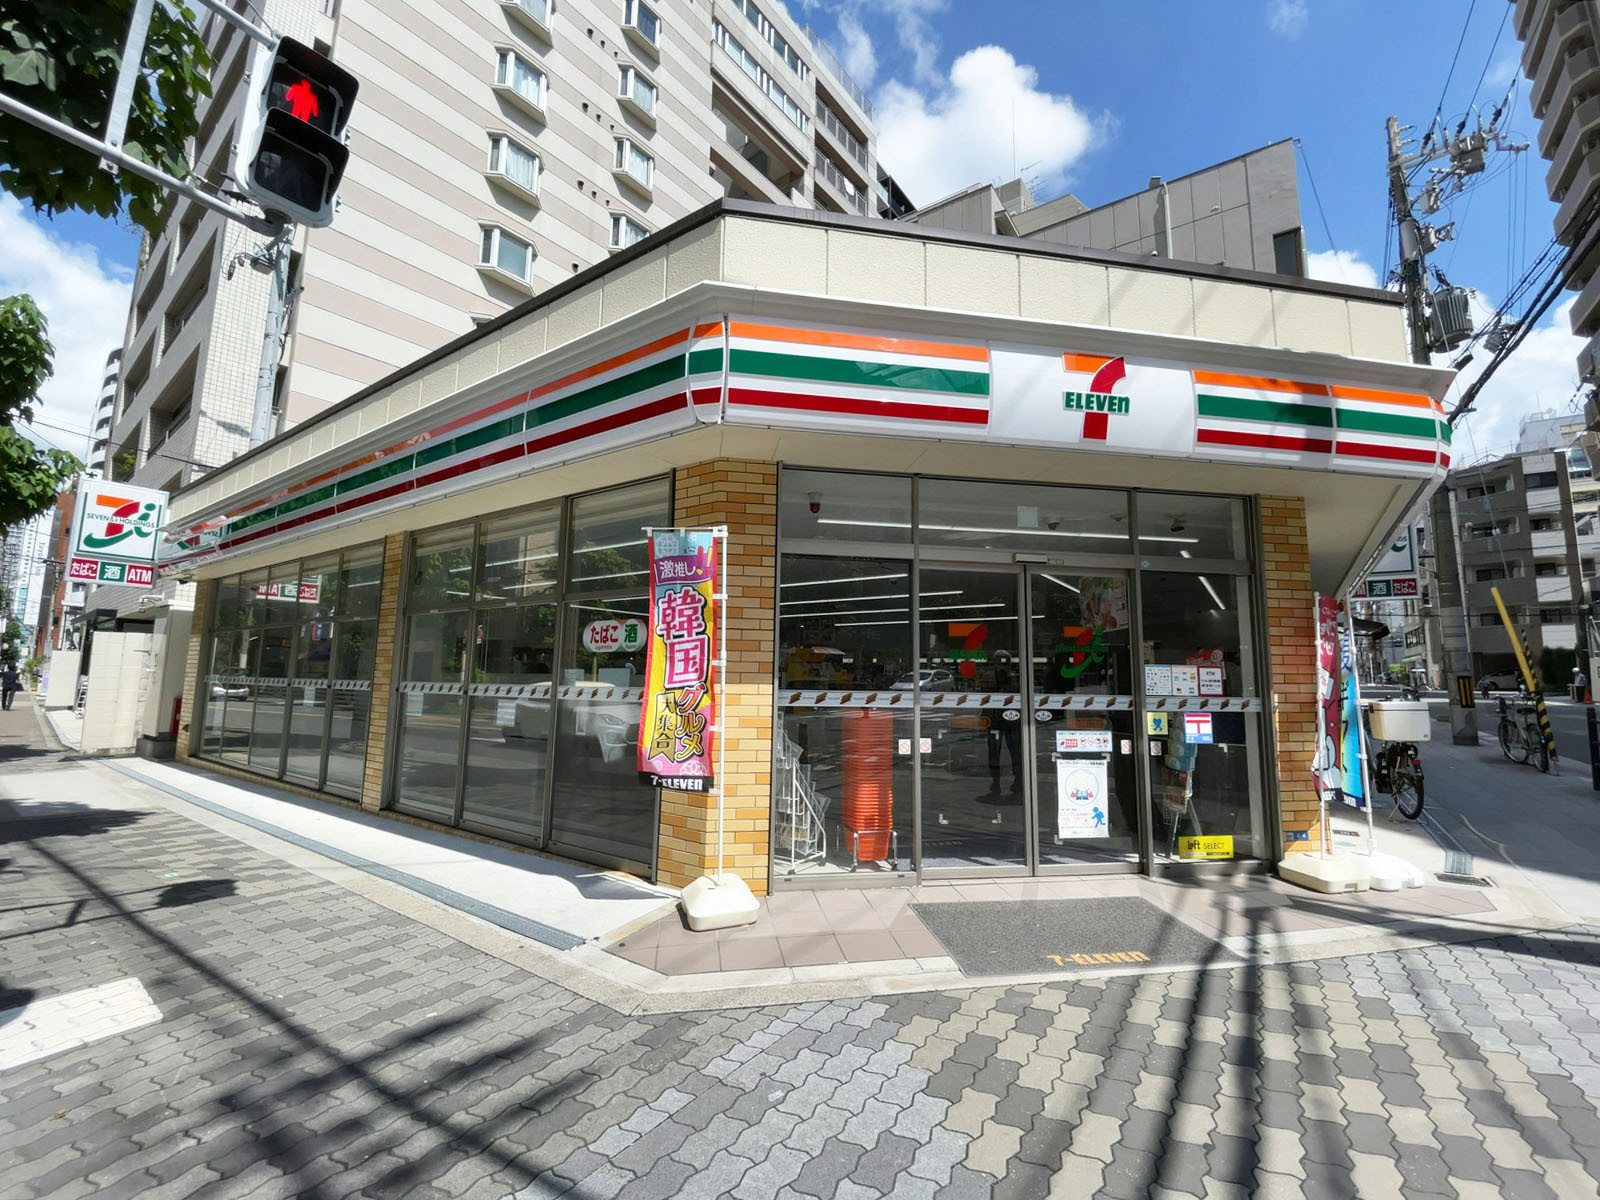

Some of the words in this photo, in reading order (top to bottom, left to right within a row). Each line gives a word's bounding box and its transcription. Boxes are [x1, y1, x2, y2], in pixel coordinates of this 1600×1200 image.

[70, 561, 97, 577] たばこ
[103, 564, 122, 580] 酒
[127, 568, 152, 583] ATM
[1393, 581, 1416, 594] たばこ
[590, 624, 618, 644] たばこ
[624, 623, 638, 643] 酒
[1203, 842, 1224, 850] SELECT
